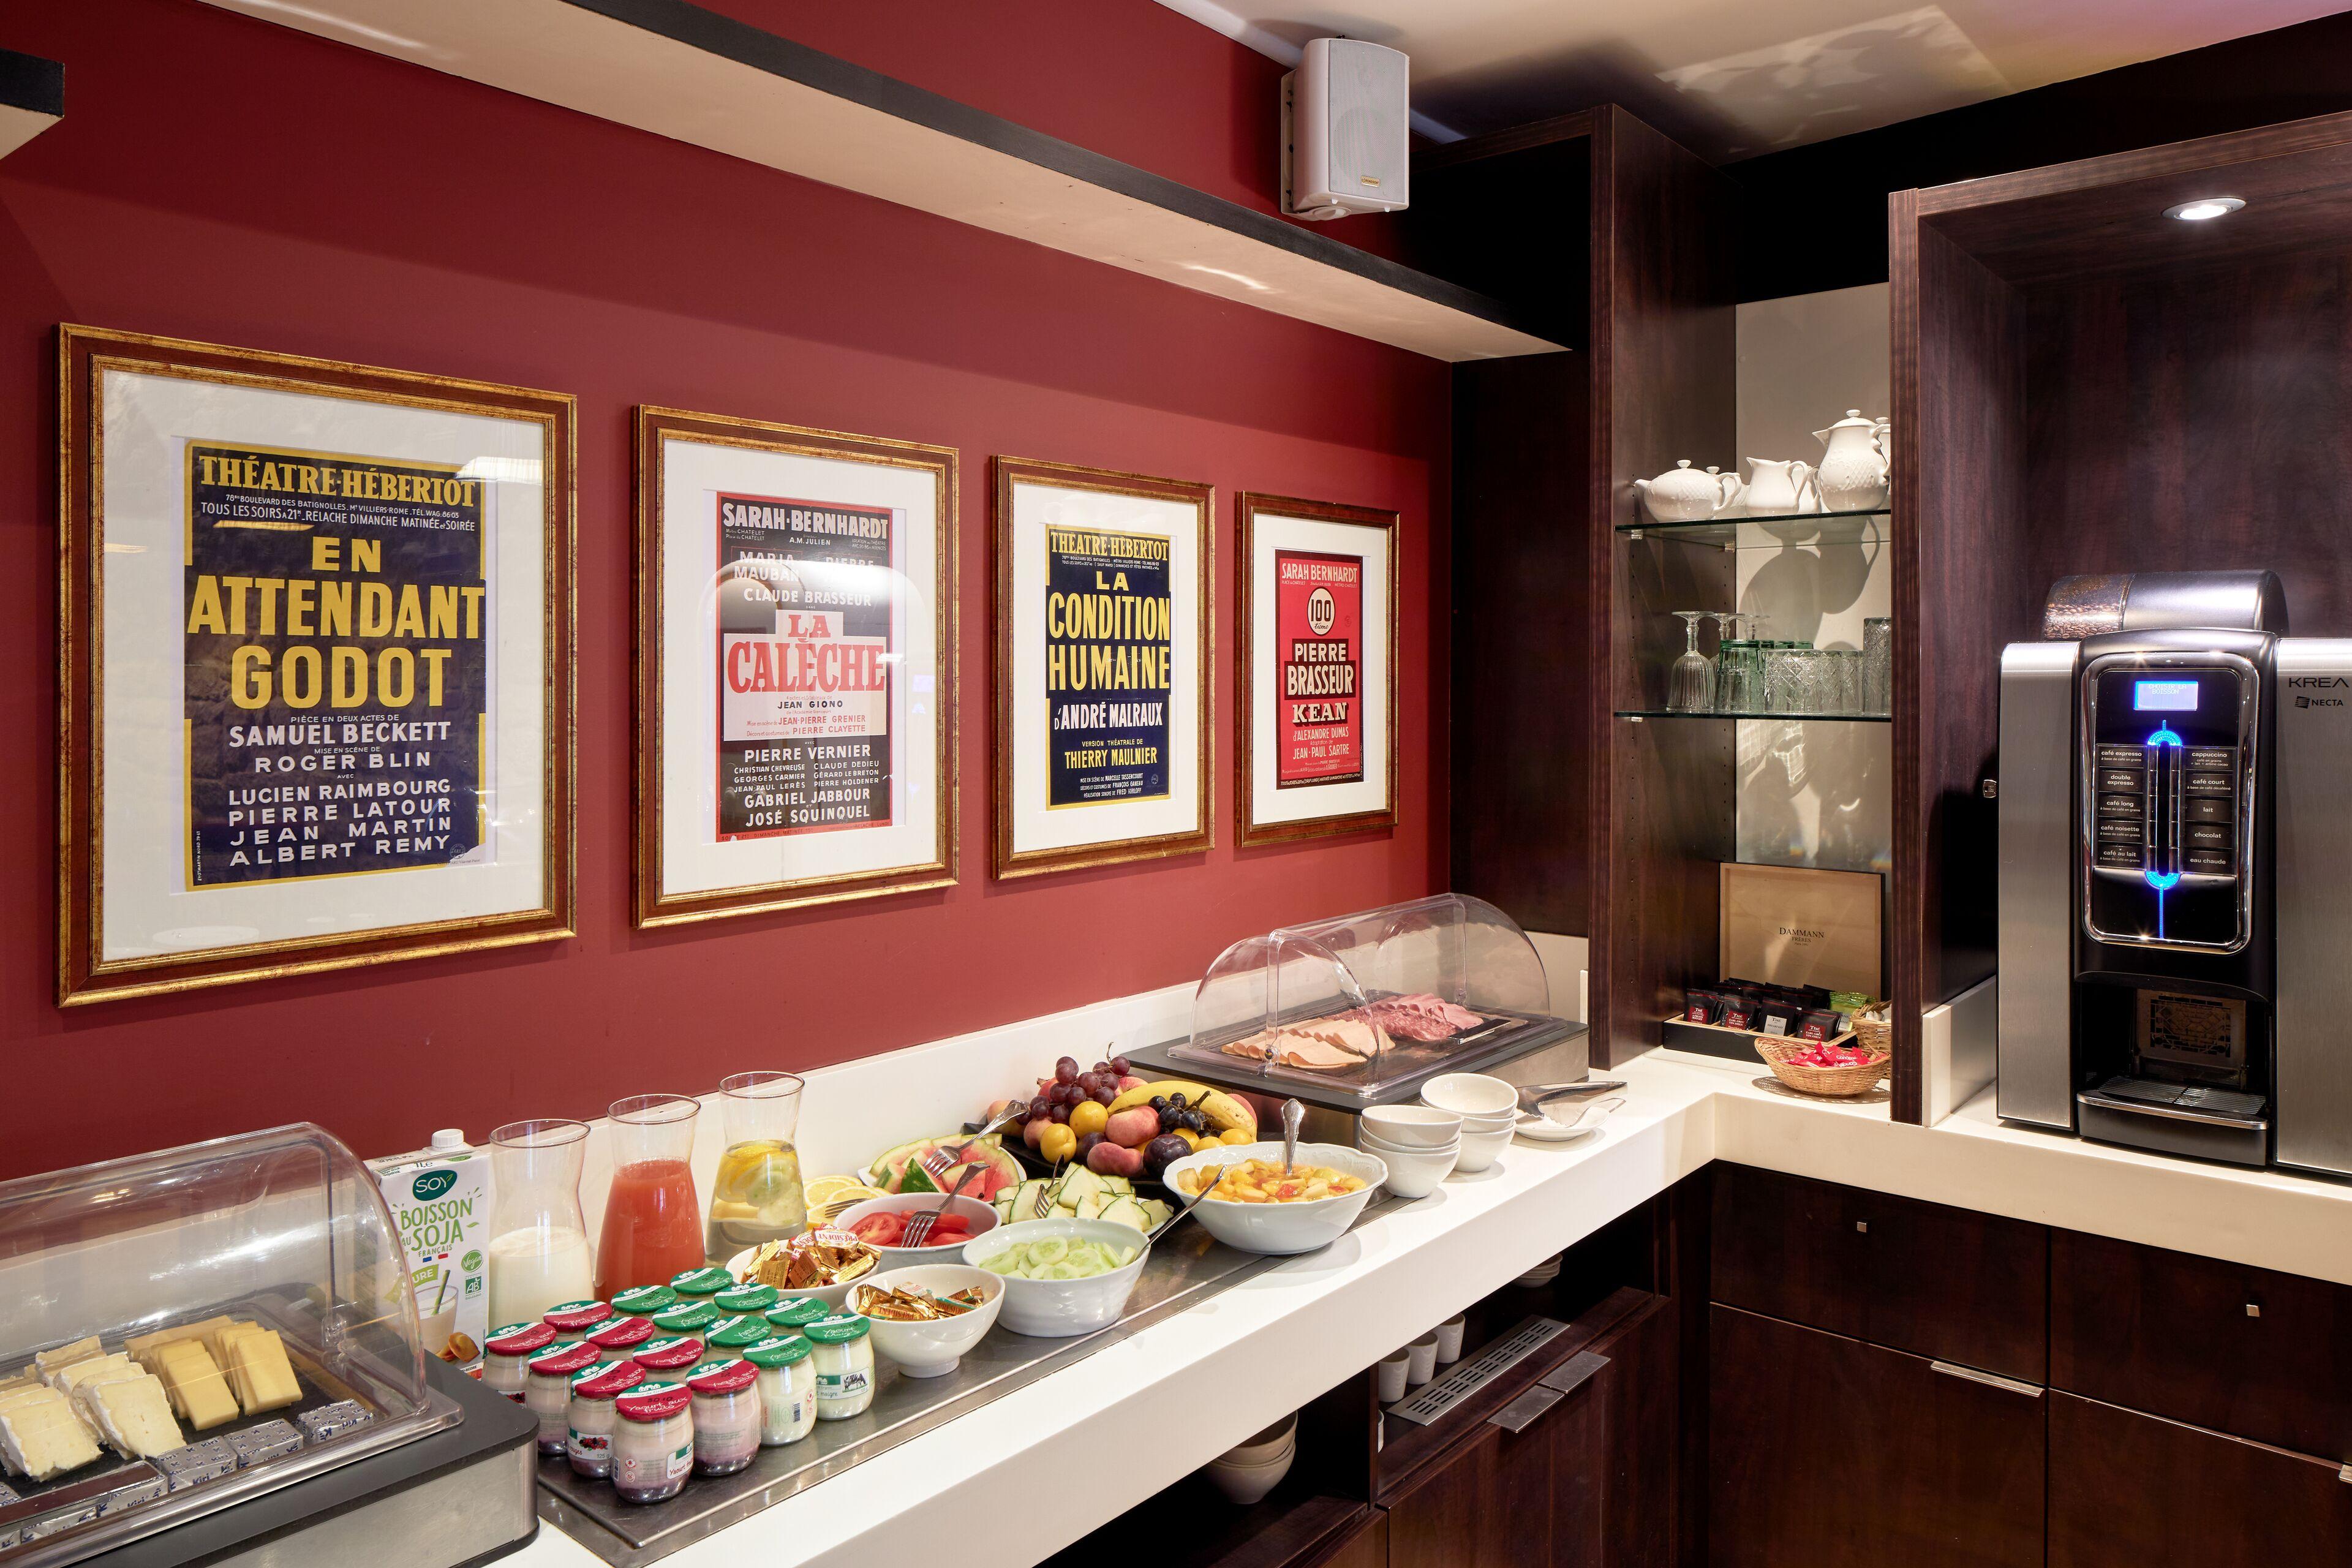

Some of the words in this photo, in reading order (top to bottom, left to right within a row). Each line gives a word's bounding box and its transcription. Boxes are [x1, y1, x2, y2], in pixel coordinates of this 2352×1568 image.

[240, 494, 280, 505] BOULEVARD
[201, 502, 230, 515] TOUS
[233, 505, 250, 517] LES
[251, 506, 282, 519] SOIRS
[306, 510, 347, 524] RELACHE
[350, 513, 398, 527] DIMANCHE
[401, 517, 440, 529] MATINÉE
[445, 519, 475, 532] SOIRÉE
[312, 536, 380, 573] EN
[1096, 571, 1129, 591] LA
[1281, 562, 1309, 580] SARAH
[1311, 564, 1358, 583] BERNHARDT
[744, 587, 799, 603] CLAUDE
[805, 590, 872, 606] BRASSEUR
[187, 575, 485, 639] ATTENDANT
[1048, 592, 1170, 641] CONDITION
[1311, 598, 1332, 622] 100
[788, 614, 831, 638] LA
[1294, 643, 1346, 662] PIERRE
[727, 638, 885, 693] CALÈCHE
[1049, 645, 1170, 691] HUMAINE
[231, 644, 452, 710] GODOT
[1287, 665, 1354, 696] BRASSEUR
[2288, 676, 2350, 688] KREA
[777, 701, 802, 709] JEAN
[809, 699, 843, 709] GIONO
[2312, 698, 2343, 707] NECTA
[290, 715, 319, 723] PIÈCE
[778, 715, 827, 726] JEAN-PIERRE
[832, 714, 866, 723] GRENIER
[1109, 702, 1163, 728] MALRAUX
[1292, 702, 1348, 725] KEAN
[228, 724, 336, 748] SAMUEL
[343, 721, 451, 744] BECKETT
[793, 726, 824, 735] PIERRE
[828, 725, 865, 733] CLAYETTE
[1293, 728, 1329, 742] d'ALEXANDRE
[1331, 726, 1349, 739] DUMAS
[1107, 738, 1135, 747] THÉATRALE
[1329, 744, 1349, 757] SARTRE
[255, 754, 355, 773] ROGER
[369, 752, 430, 769] BLIN
[744, 747, 801, 763] PIERRE
[807, 744, 871, 760] VERNIER
[1065, 749, 1108, 769] THIERRY
[1111, 747, 1158, 766] MAULNIER
[734, 766, 769, 774] CHRISTIAN
[771, 764, 805, 772] CHEVREUSE
[813, 770, 843, 779] GÉRARD
[734, 775, 772, 783] GEORGES
[734, 784, 775, 793] JEAN-PAUL
[842, 777, 879, 786] HOLDENER
[229, 786, 310, 806] LUCIEN
[319, 778, 450, 801] RAIMBOURG
[744, 791, 806, 809] GABRIEL
[810, 788, 870, 804] JABBOUR
[228, 804, 337, 827] PIERRE
[353, 797, 451, 819] LATOUR
[745, 809, 782, 827] JOSÉ
[790, 805, 870, 824] SQUINQUEL
[230, 826, 318, 846] JEAN
[349, 816, 451, 837] MARTIN
[229, 842, 356, 867] ALBERT
[375, 835, 450, 854] REMY
[1779, 927, 1825, 938] DAMMANN
[415, 1174, 454, 1193] SOY
[400, 1197, 473, 1231] BOISSON
[401, 1236, 412, 1247] AU
[411, 1219, 464, 1251] SOJA
[418, 1245, 453, 1257] FRANÇAIS
[462, 1253, 483, 1270] Vegan
[466, 1278, 480, 1294] AB
[625, 1402, 663, 1412] Yaourt
[668, 1396, 687, 1405] aux
[201, 1438, 219, 1447] Kiri
[192, 1472, 210, 1485] Kiri
